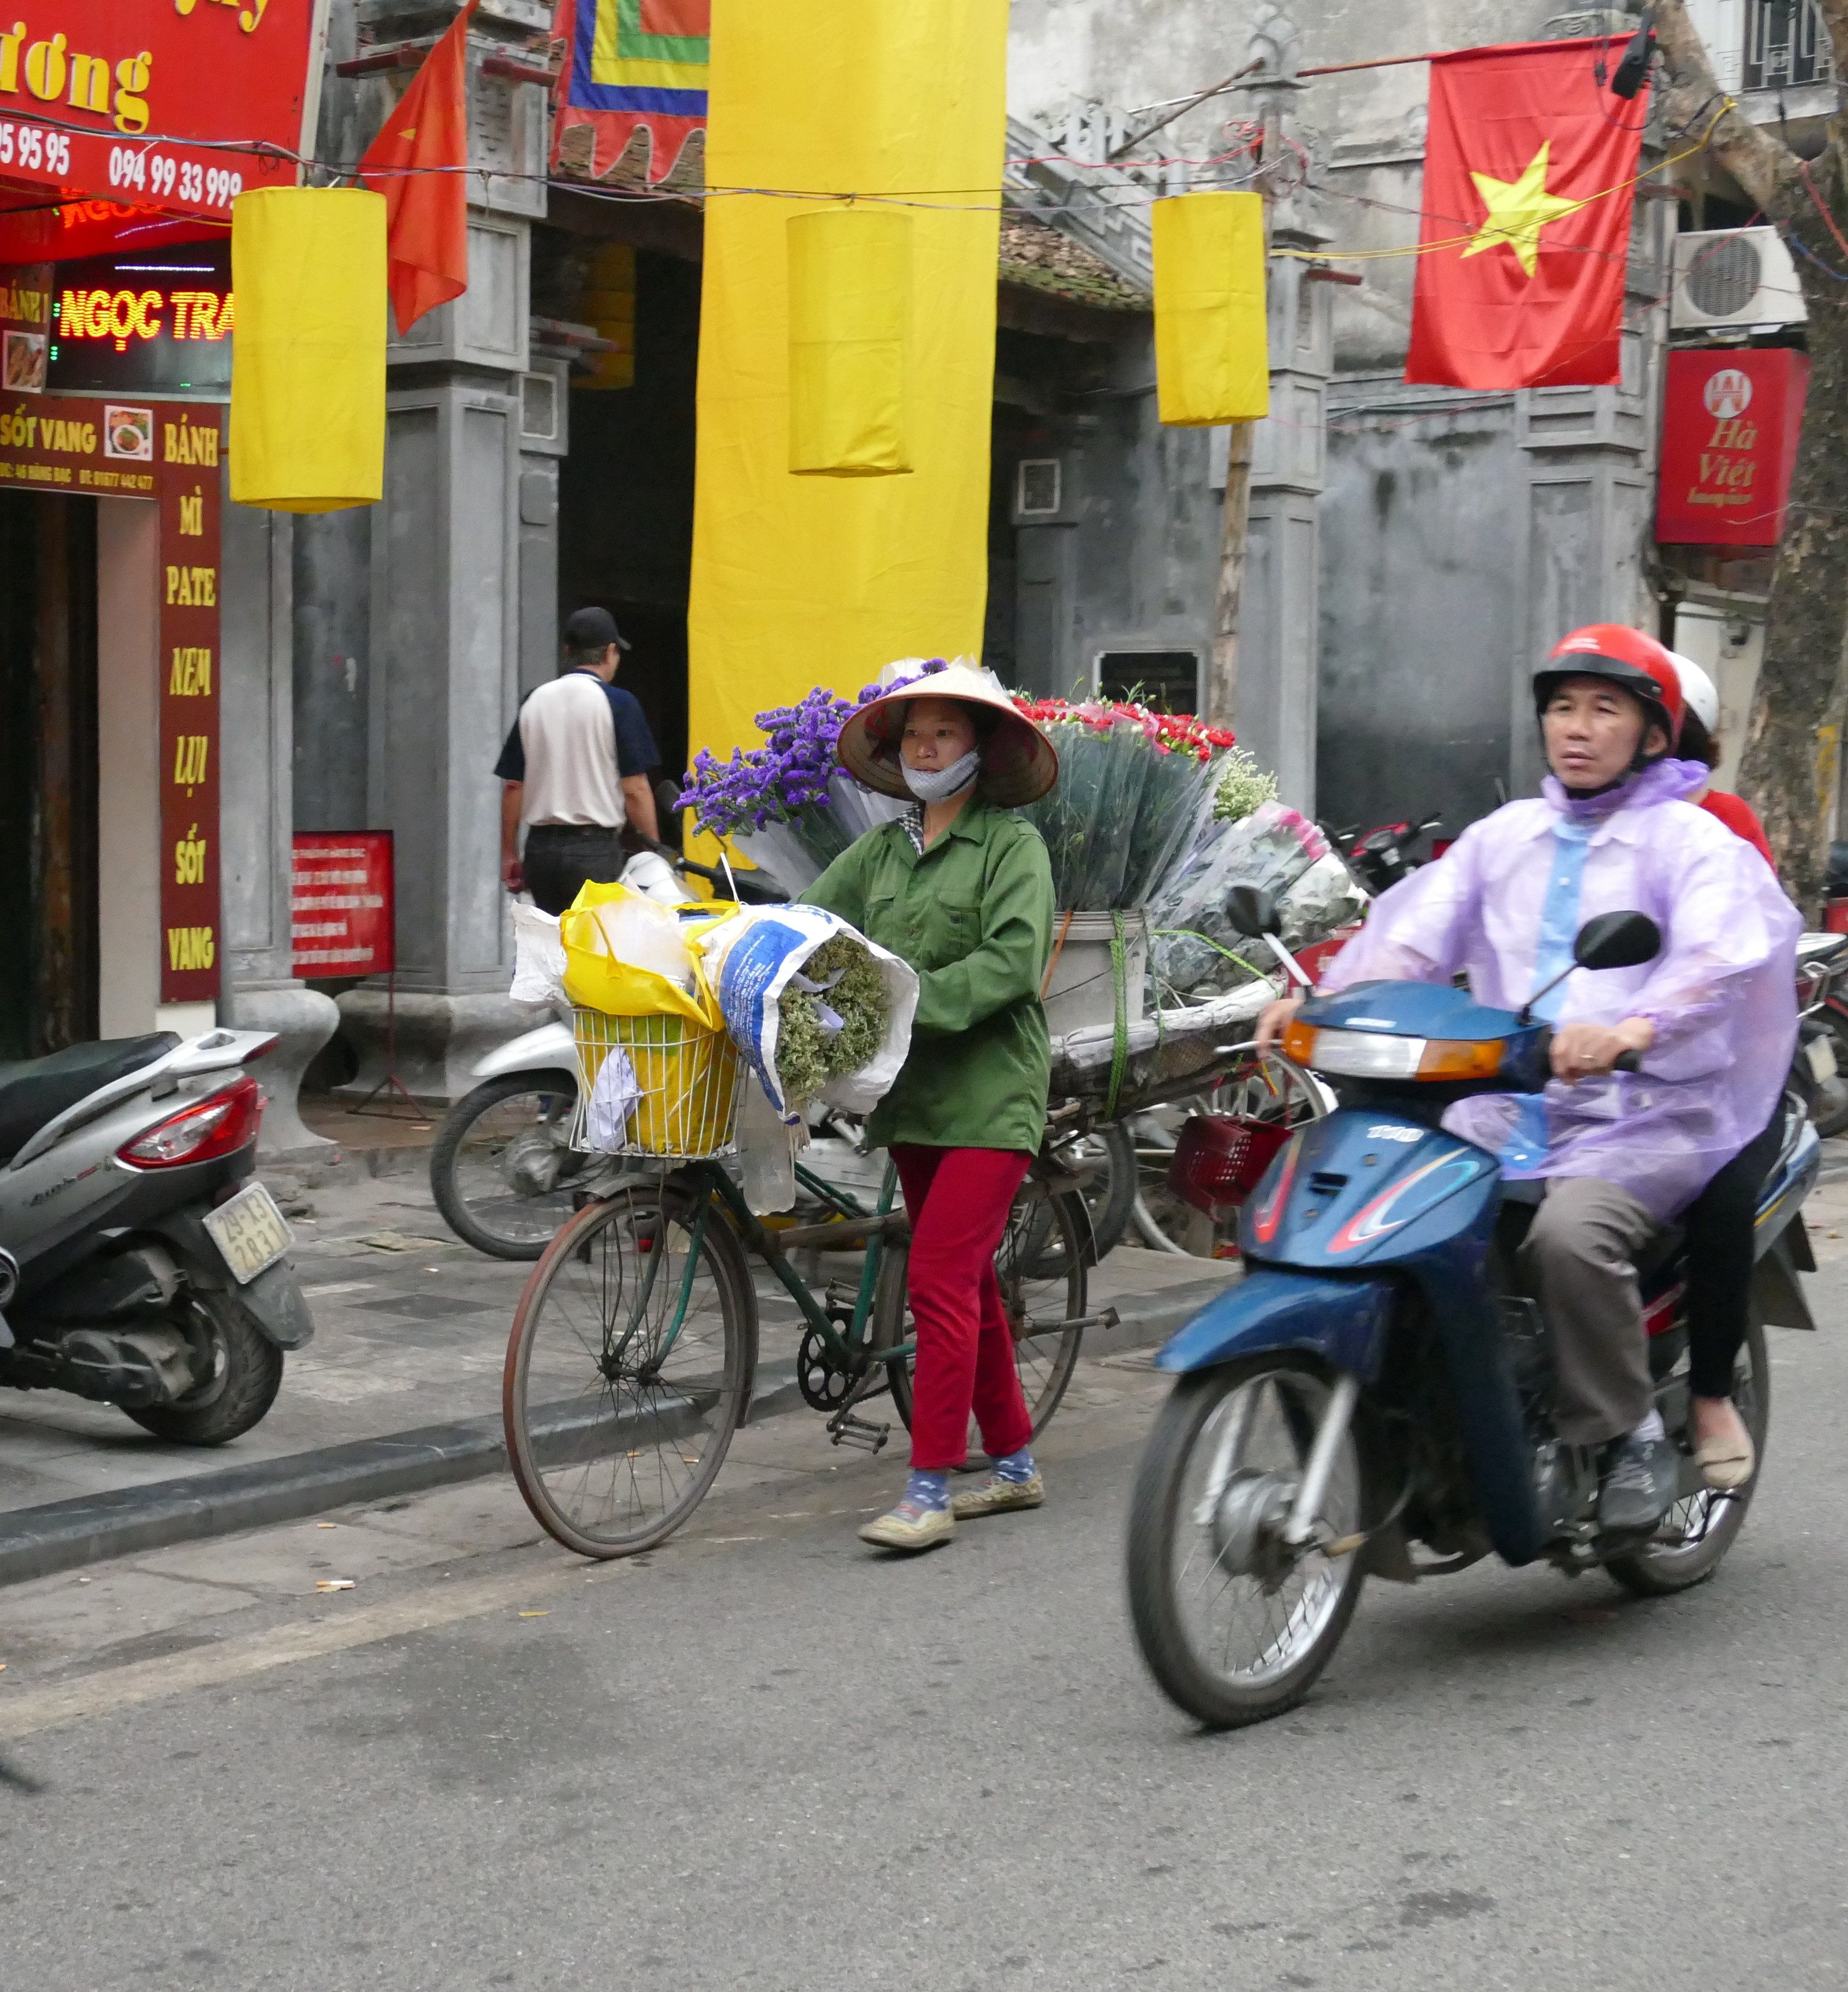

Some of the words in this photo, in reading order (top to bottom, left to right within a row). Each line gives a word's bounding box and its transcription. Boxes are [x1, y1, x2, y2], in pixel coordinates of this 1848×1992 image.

[18, 126, 43, 169] 95
[45, 132, 70, 175] 95
[110, 146, 146, 191] 094
[151, 155, 176, 197] 99
[179, 161, 203, 203] 33
[206, 167, 242, 210] 999
[60, 290, 163, 351] NGỌC
[39, 418, 97, 454] VANG
[164, 412, 219, 467] BÁNH
[166, 566, 216, 607] PATE
[169, 647, 212, 696] NEM
[168, 927, 215, 971] VANG
